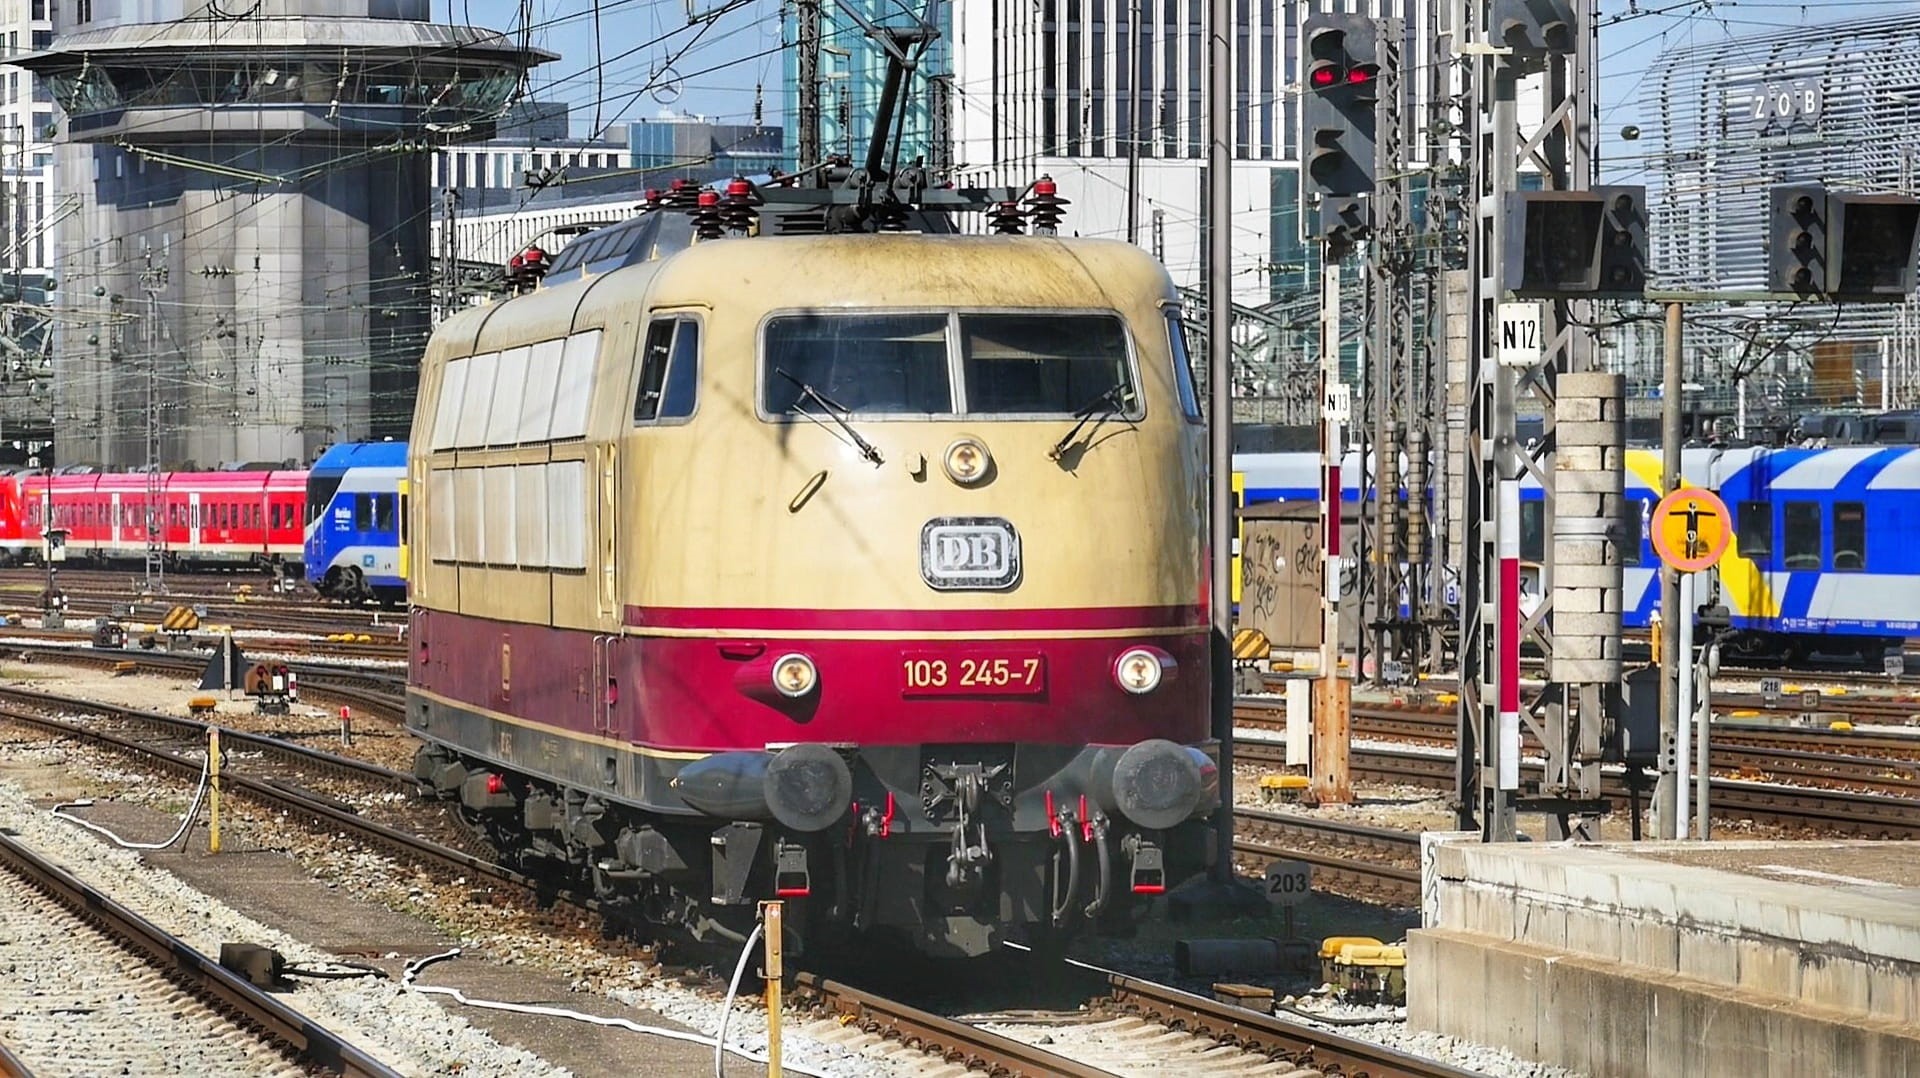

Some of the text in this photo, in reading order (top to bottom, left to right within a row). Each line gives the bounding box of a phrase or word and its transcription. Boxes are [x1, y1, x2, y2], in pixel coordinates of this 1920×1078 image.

[938, 534, 998, 567] DB
[904, 658, 1039, 687] 103 245-7
[1763, 681, 1779, 693] 218
[1270, 873, 1306, 893] 203
